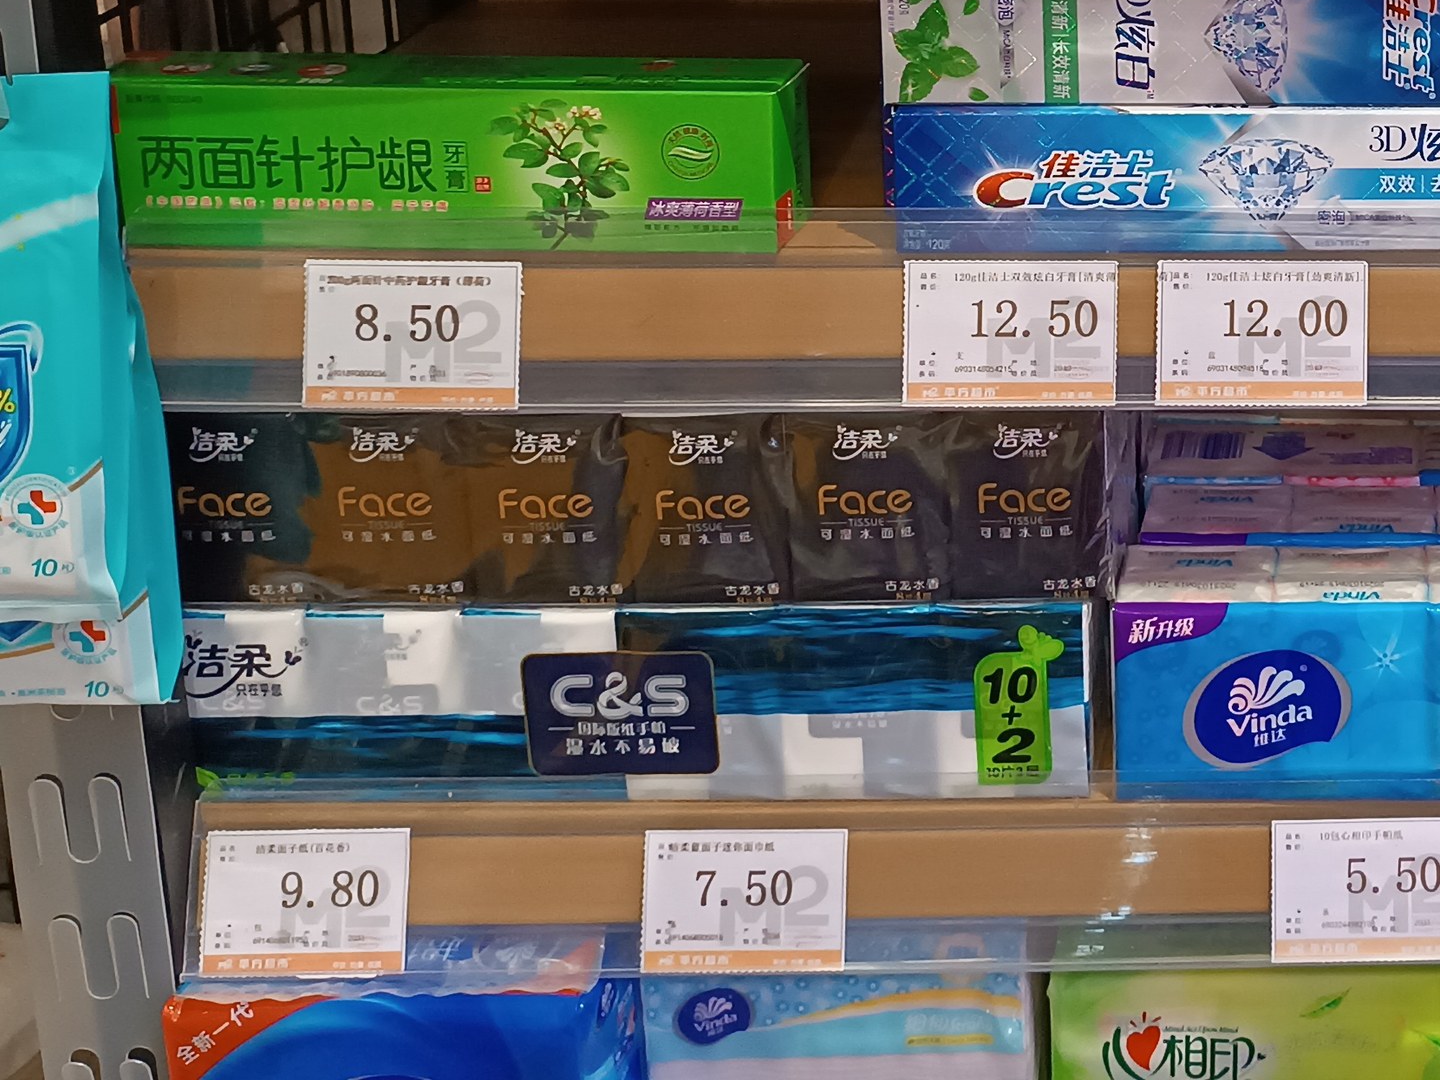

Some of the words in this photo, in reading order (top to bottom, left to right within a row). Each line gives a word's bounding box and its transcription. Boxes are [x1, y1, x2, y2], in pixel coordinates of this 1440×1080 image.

[136, 135, 437, 194] 两面针护龈
[1041, 149, 1156, 181] 佳洁士
[974, 168, 1173, 210] Crest
[1379, 175, 1416, 195] 双效
[354, 303, 460, 343] 8.50
[970, 299, 1098, 338] 12.50
[1223, 299, 1348, 337] 12.00
[177, 486, 273, 518] Face
[336, 486, 433, 518] Face
[498, 488, 595, 520] Face
[655, 489, 751, 520] Face
[818, 484, 913, 516] Face
[978, 482, 1072, 514] Face
[30, 557, 58, 578] 10
[1127, 617, 1195, 644] 新升级
[183, 634, 300, 697] 洁柔
[84, 680, 110, 698] 10
[551, 672, 690, 720] C&S
[983, 667, 1038, 705] 10
[1226, 702, 1313, 738] Vinda
[1253, 728, 1287, 748] 维达
[992, 729, 1036, 765] 2
[280, 869, 379, 909] 9.80
[695, 869, 793, 907] 7.50
[175, 1001, 254, 1068] 全新一代
